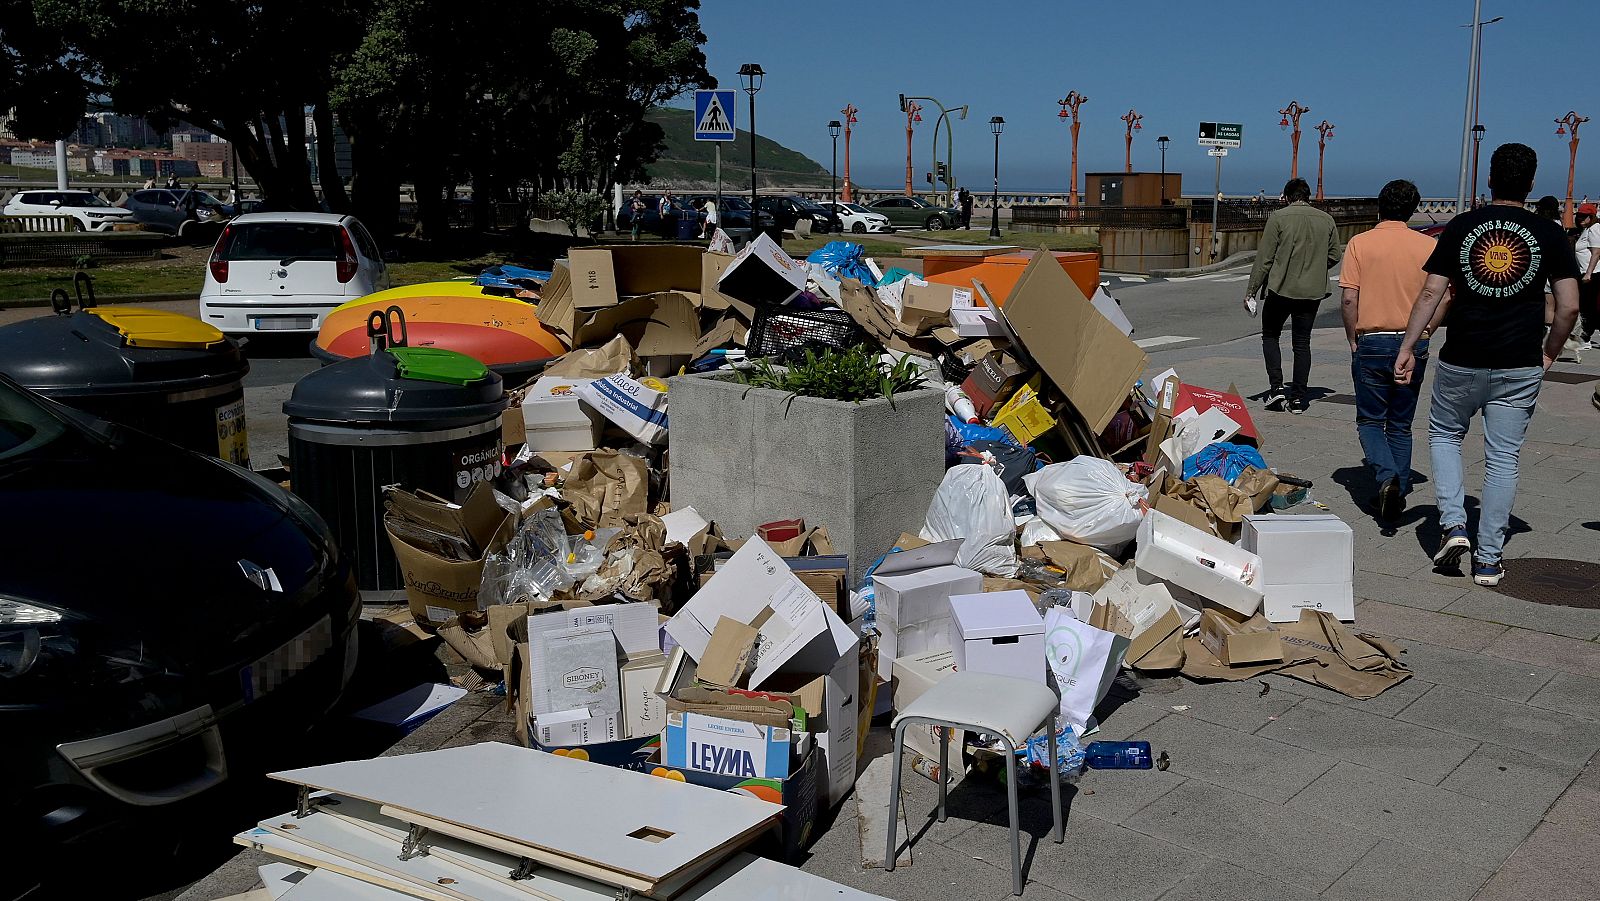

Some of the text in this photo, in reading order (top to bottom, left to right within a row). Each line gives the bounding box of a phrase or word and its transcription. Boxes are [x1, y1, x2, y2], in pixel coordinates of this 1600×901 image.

[1472, 220, 1494, 237] DAYS
[1495, 219, 1502, 229] &
[1502, 220, 1521, 233] SUN
[1516, 227, 1538, 247] RAYS
[1460, 232, 1477, 264] ENDLESS
[1489, 250, 1508, 261] VANS
[1461, 264, 1472, 272] &
[1521, 254, 1541, 285] ENDLESS
[1464, 271, 1481, 290] RAYS
[1476, 284, 1495, 297] SUN
[1495, 287, 1502, 298] &
[1503, 280, 1524, 297] DAYS
[566, 671, 600, 683] SIBONEY
[707, 723, 745, 734] LECHE ENTERA
[691, 741, 757, 778] LEYMA
